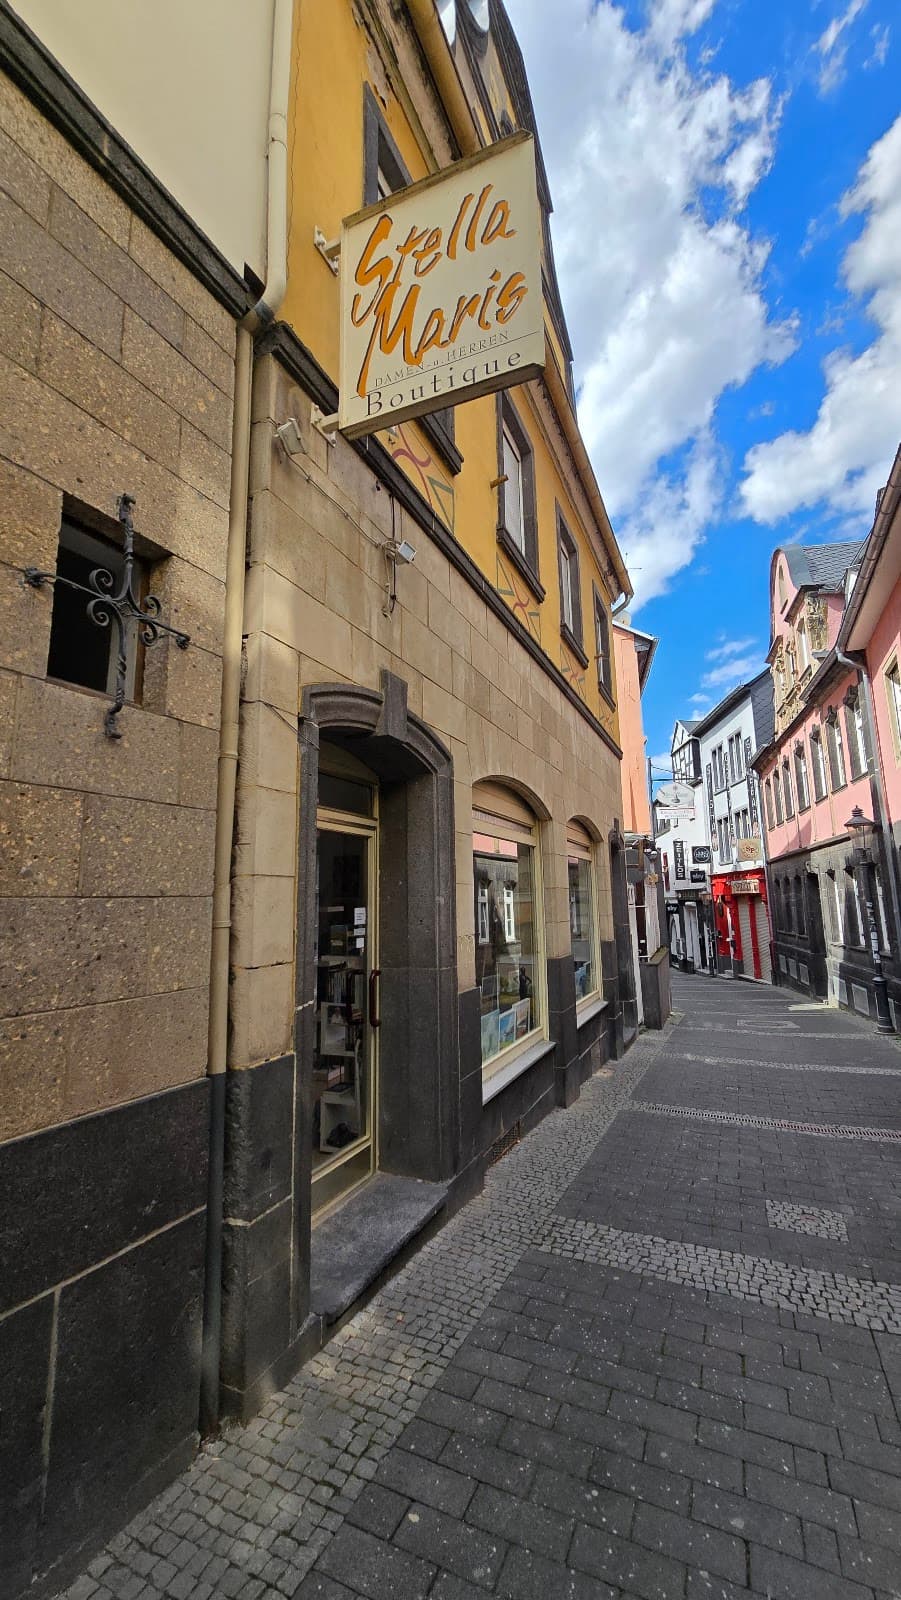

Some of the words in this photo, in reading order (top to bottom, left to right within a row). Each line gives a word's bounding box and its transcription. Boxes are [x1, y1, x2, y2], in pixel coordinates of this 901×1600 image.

[351, 184, 518, 328] Stella
[356, 269, 529, 398] Maris
[447, 330, 509, 360] HERREN
[365, 351, 522, 417] Boutique
